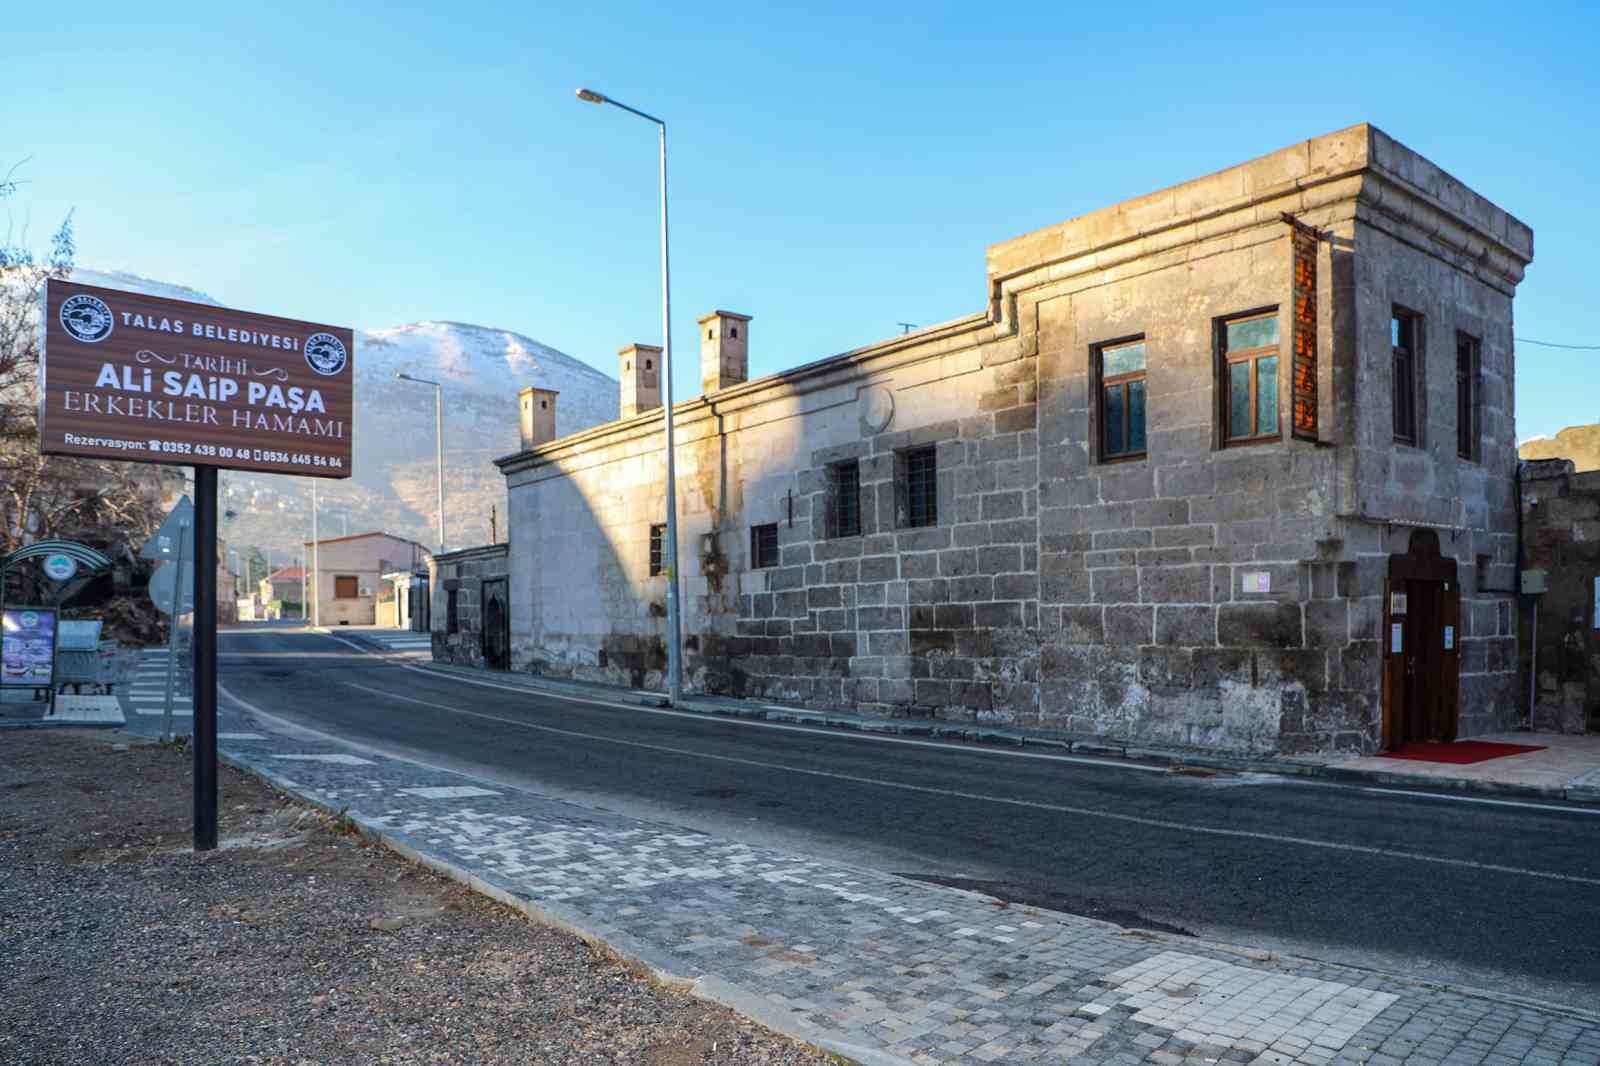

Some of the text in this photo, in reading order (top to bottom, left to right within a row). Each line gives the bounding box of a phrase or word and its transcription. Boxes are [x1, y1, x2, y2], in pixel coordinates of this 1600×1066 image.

[121, 311, 299, 351] TALAS BELEDİYESİ
[179, 352, 248, 376] TARİHİ
[95, 363, 326, 415] ALİ SAİP PAŞA
[63, 390, 344, 438] ERKEKLER HAMAMI
[64, 432, 146, 451] Rezervasyon:
[162, 441, 192, 455] 0352
[194, 444, 216, 456] 438
[218, 446, 233, 458] 00
[236, 448, 251, 460] 48
